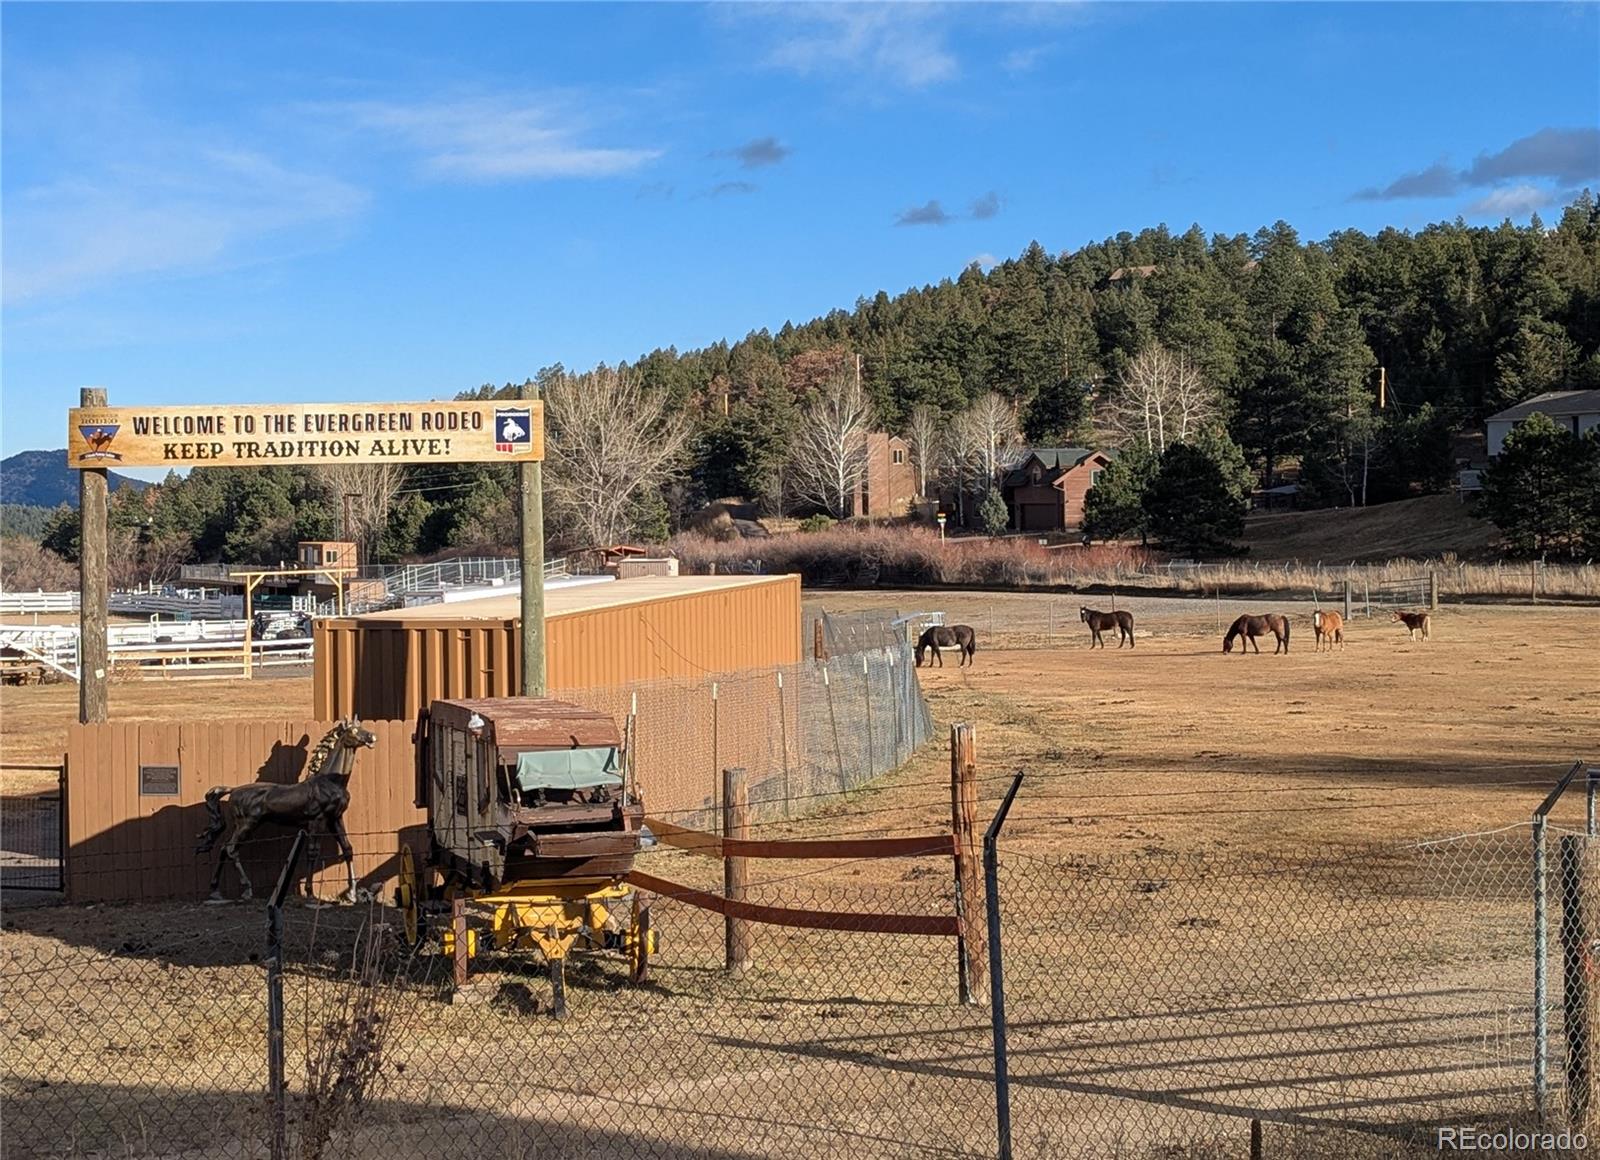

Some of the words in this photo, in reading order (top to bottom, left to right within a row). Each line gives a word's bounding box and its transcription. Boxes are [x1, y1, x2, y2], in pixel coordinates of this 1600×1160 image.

[132, 415, 225, 436] WELCOME
[233, 415, 256, 435] TO
[263, 414, 297, 434] THE
[304, 411, 414, 433] EVERGREEN
[421, 410, 484, 432] RODEO
[163, 442, 224, 460] KEEP
[232, 440, 360, 459] TRADITION
[368, 438, 451, 457] ALIVE!
